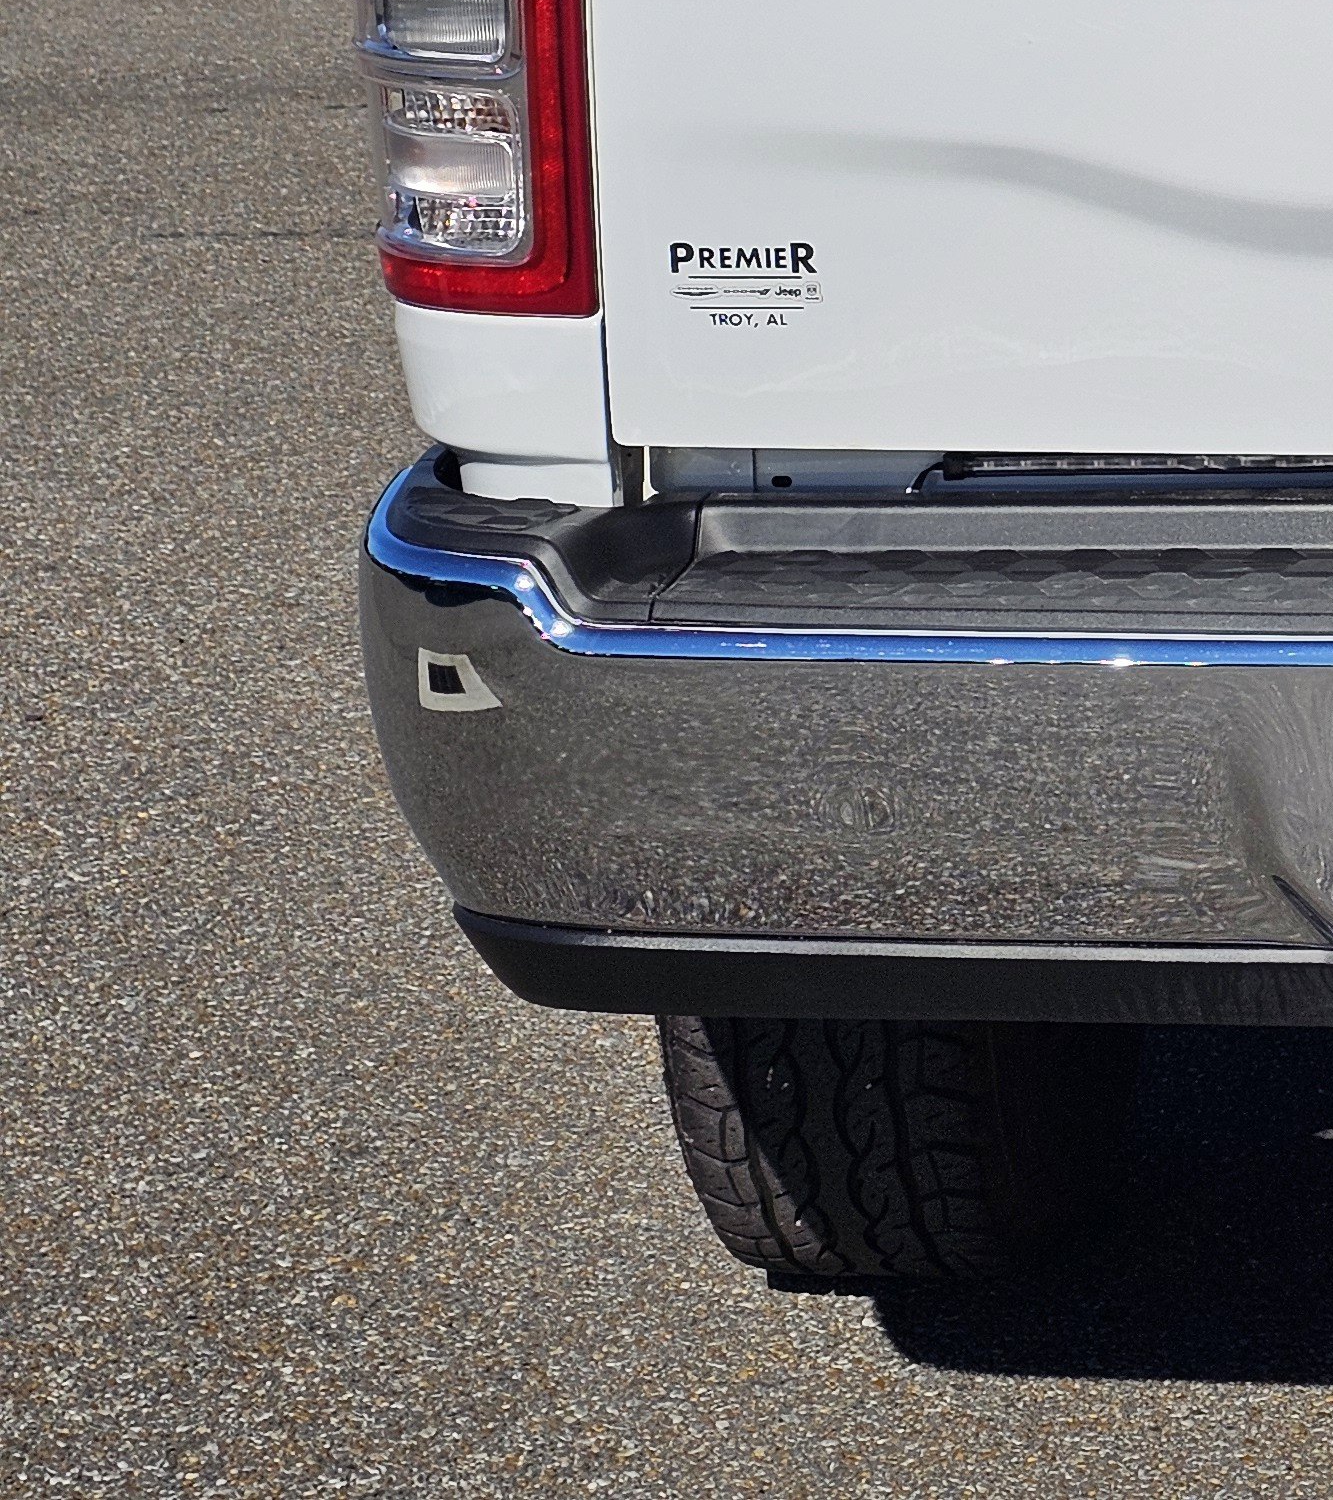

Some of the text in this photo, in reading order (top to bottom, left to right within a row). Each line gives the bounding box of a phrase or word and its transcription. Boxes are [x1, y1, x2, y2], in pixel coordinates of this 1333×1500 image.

[669, 242, 818, 274] PREMIER
[774, 285, 802, 298] Jeep
[709, 313, 788, 328] TROY, AL
